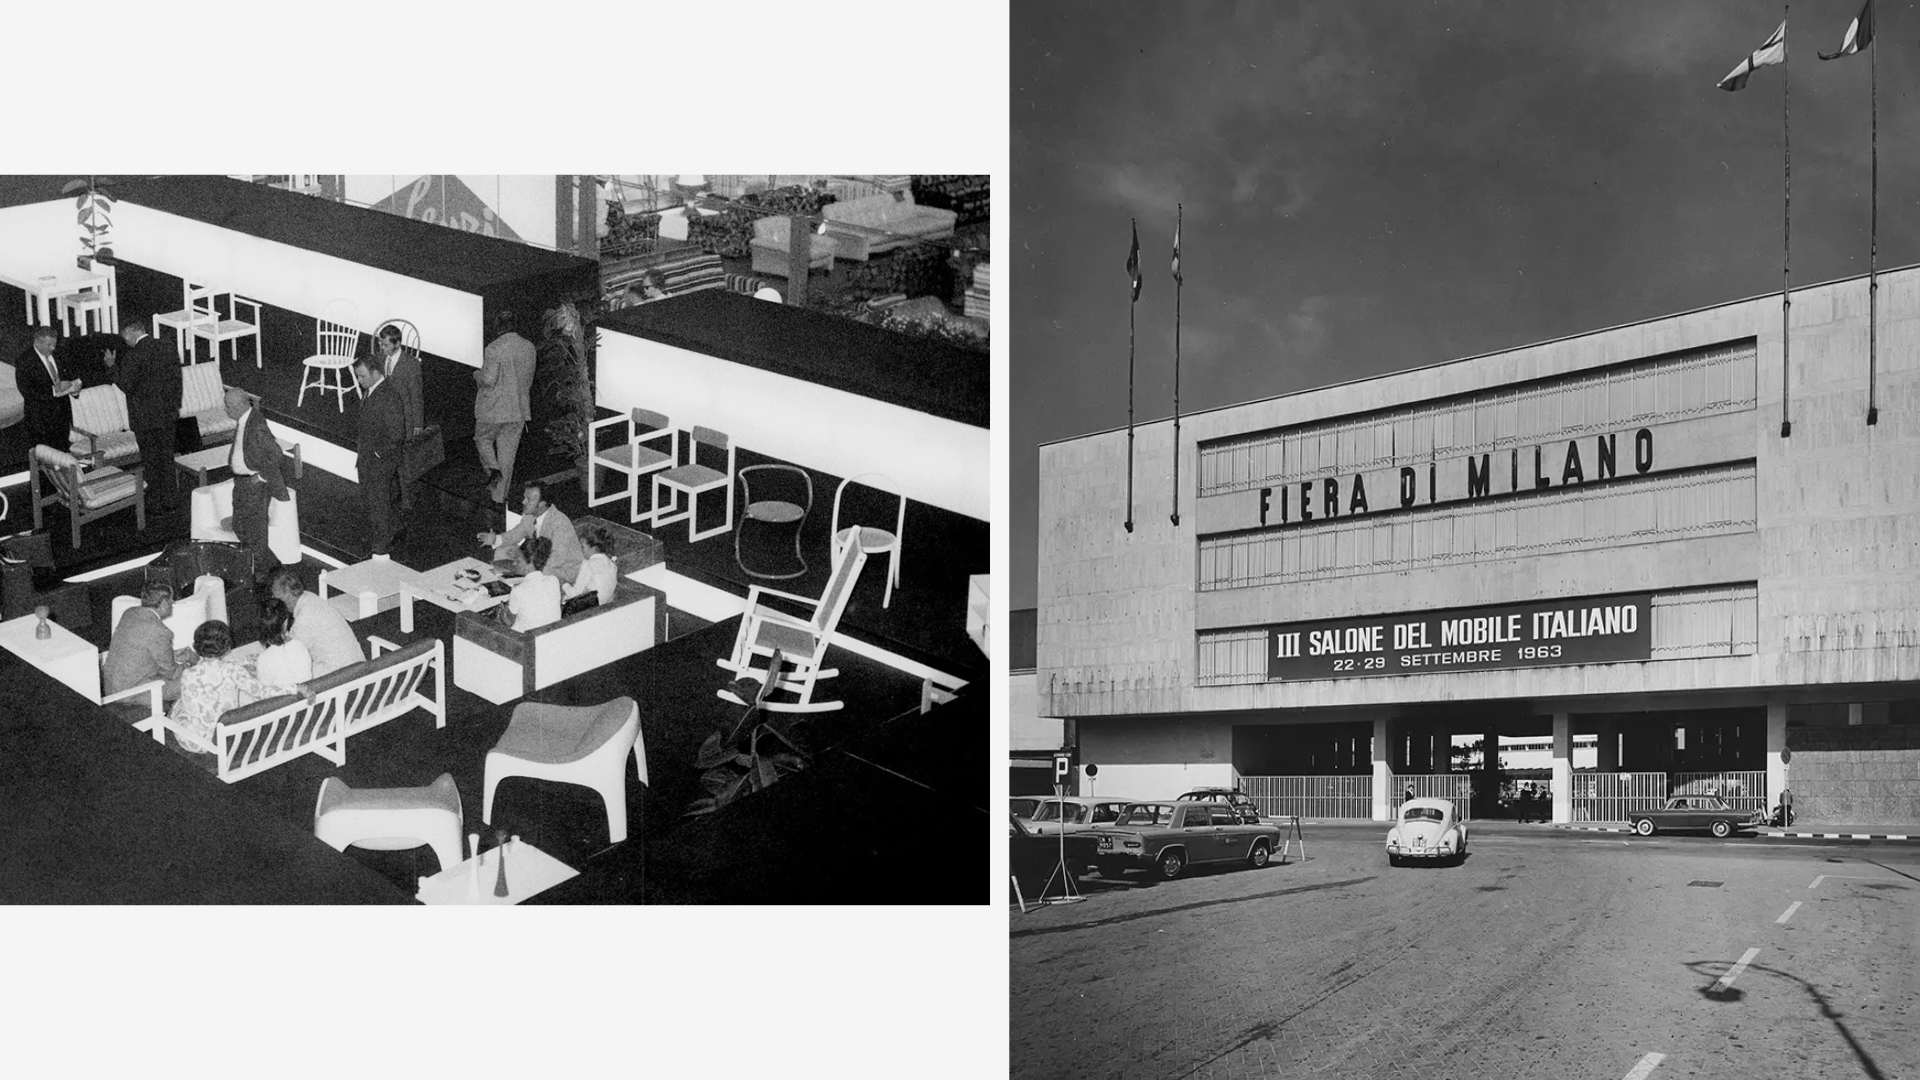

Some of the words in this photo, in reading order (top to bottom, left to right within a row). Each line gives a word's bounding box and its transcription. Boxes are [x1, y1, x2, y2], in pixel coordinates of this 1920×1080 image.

[1259, 473, 1369, 525] FIERA
[1400, 462, 1437, 507] DI
[1468, 428, 1653, 498] MILANO
[1277, 632, 1301, 659] III
[1309, 626, 1384, 657] SALONE
[1393, 622, 1433, 651] DEL
[1440, 614, 1522, 647] MOBILE
[1532, 604, 1638, 640] ITALIANO
[1400, 649, 1502, 668] SETTEMBRE
[1517, 644, 1563, 661] 1963
[1055, 757, 1069, 783] P
